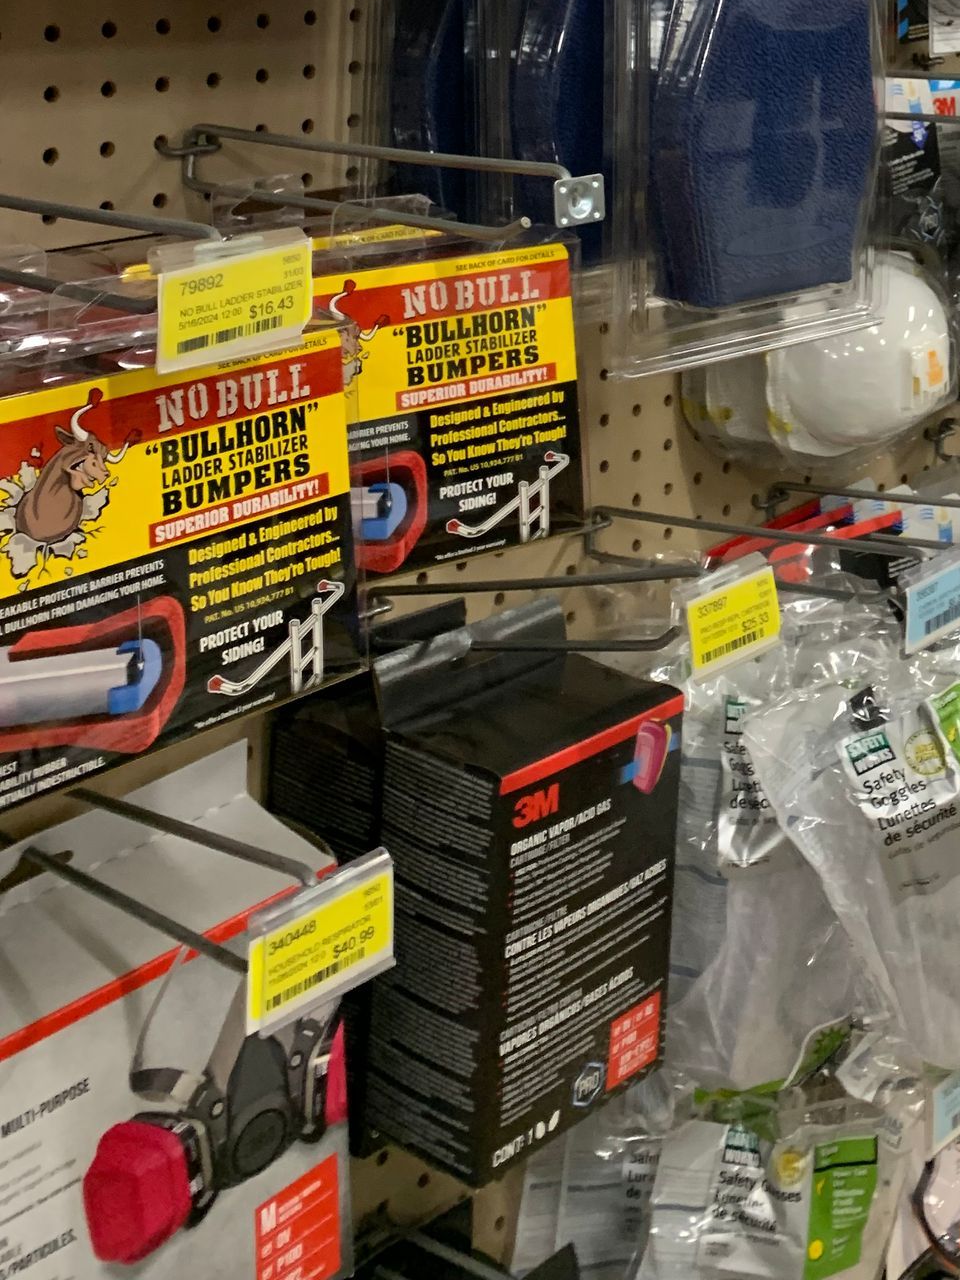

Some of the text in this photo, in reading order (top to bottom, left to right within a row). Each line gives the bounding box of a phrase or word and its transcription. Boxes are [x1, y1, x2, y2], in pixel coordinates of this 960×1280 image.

[933, 96, 957, 117] 3M
[468, 250, 555, 270] BACK CARD FOR DETAILS
[179, 272, 224, 297] 79892
[179, 279, 304, 319] NO BULL LADDER STABILIZER
[401, 270, 540, 320] NO BULL
[178, 312, 219, 331] 5/16/2024
[249, 295, 295, 320] $16.43
[406, 329, 537, 365] LADDER STABILIZER
[406, 345, 540, 387] BUMPERS
[155, 363, 312, 433] NO BULL
[401, 366, 548, 409] SUPERIOR DURABILITY!
[375, 420, 409, 436] PREVENTS
[430, 389, 565, 429] Designed & Engineered by
[430, 409, 567, 449] Professional Contractors...
[390, 433, 411, 447] HOME.
[431, 424, 567, 468] So You Know They're Tough!
[162, 433, 309, 490] LADDER STABILIZER
[162, 453, 311, 517] BUMPERS
[439, 471, 514, 501] PROTECT YOUR
[458, 492, 497, 513] SIDING!
[155, 478, 320, 543] SUPERIOR DURABILITY!
[188, 506, 338, 566] Designed & Engineered by
[188, 529, 340, 590] Professional Contractors...
[39, 558, 164, 609] PROTECTIVE BARRIER PREVENTS
[191, 548, 341, 612] So You Know They're Tough!
[4, 573, 167, 634] BULLHORN FROM DAMAGING YOUR HOME.
[200, 610, 284, 654] PROTECT YOUR
[221, 637, 265, 666] SIDING!
[862, 767, 907, 795] Safety
[870, 779, 927, 810] Goggles
[512, 783, 560, 828] 3M
[877, 797, 936, 831] Lunettes
[884, 804, 958, 847] de sécurité
[510, 830, 548, 856] ORGANIC
[548, 807, 596, 840] VAPOR/ACID
[268, 919, 317, 956] 340448
[538, 925, 554, 943] LES
[1, 1077, 91, 1139] MULTI-PURPOSE
[718, 1170, 756, 1192] Safety
